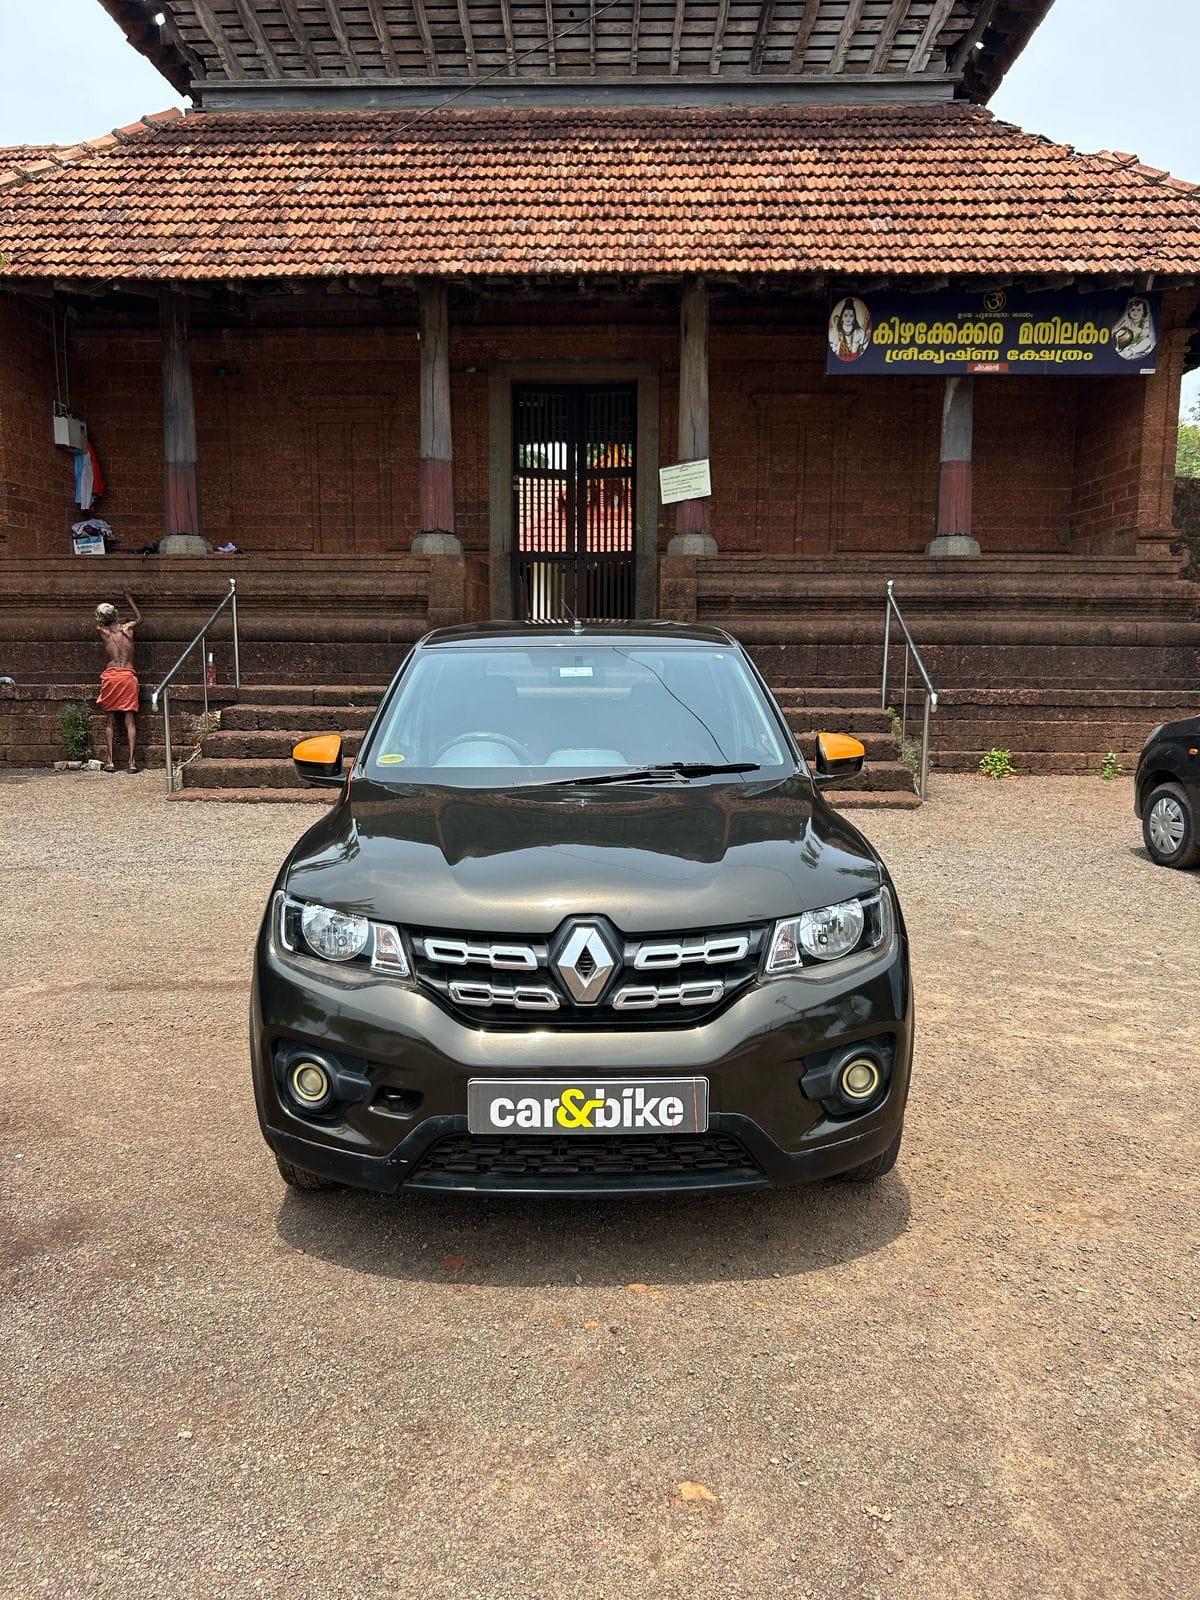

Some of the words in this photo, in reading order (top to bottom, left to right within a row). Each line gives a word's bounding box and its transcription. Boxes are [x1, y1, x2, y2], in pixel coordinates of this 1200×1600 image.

[872, 316, 1004, 345] കിഴക്കേക്കര
[1018, 315, 1110, 345] മതിലകം
[885, 347, 1000, 364] ശ്രീകൃഷ്ണ
[1006, 348, 1094, 363] ക്ഷേത്രം
[489, 1087, 685, 1129] car&bike
